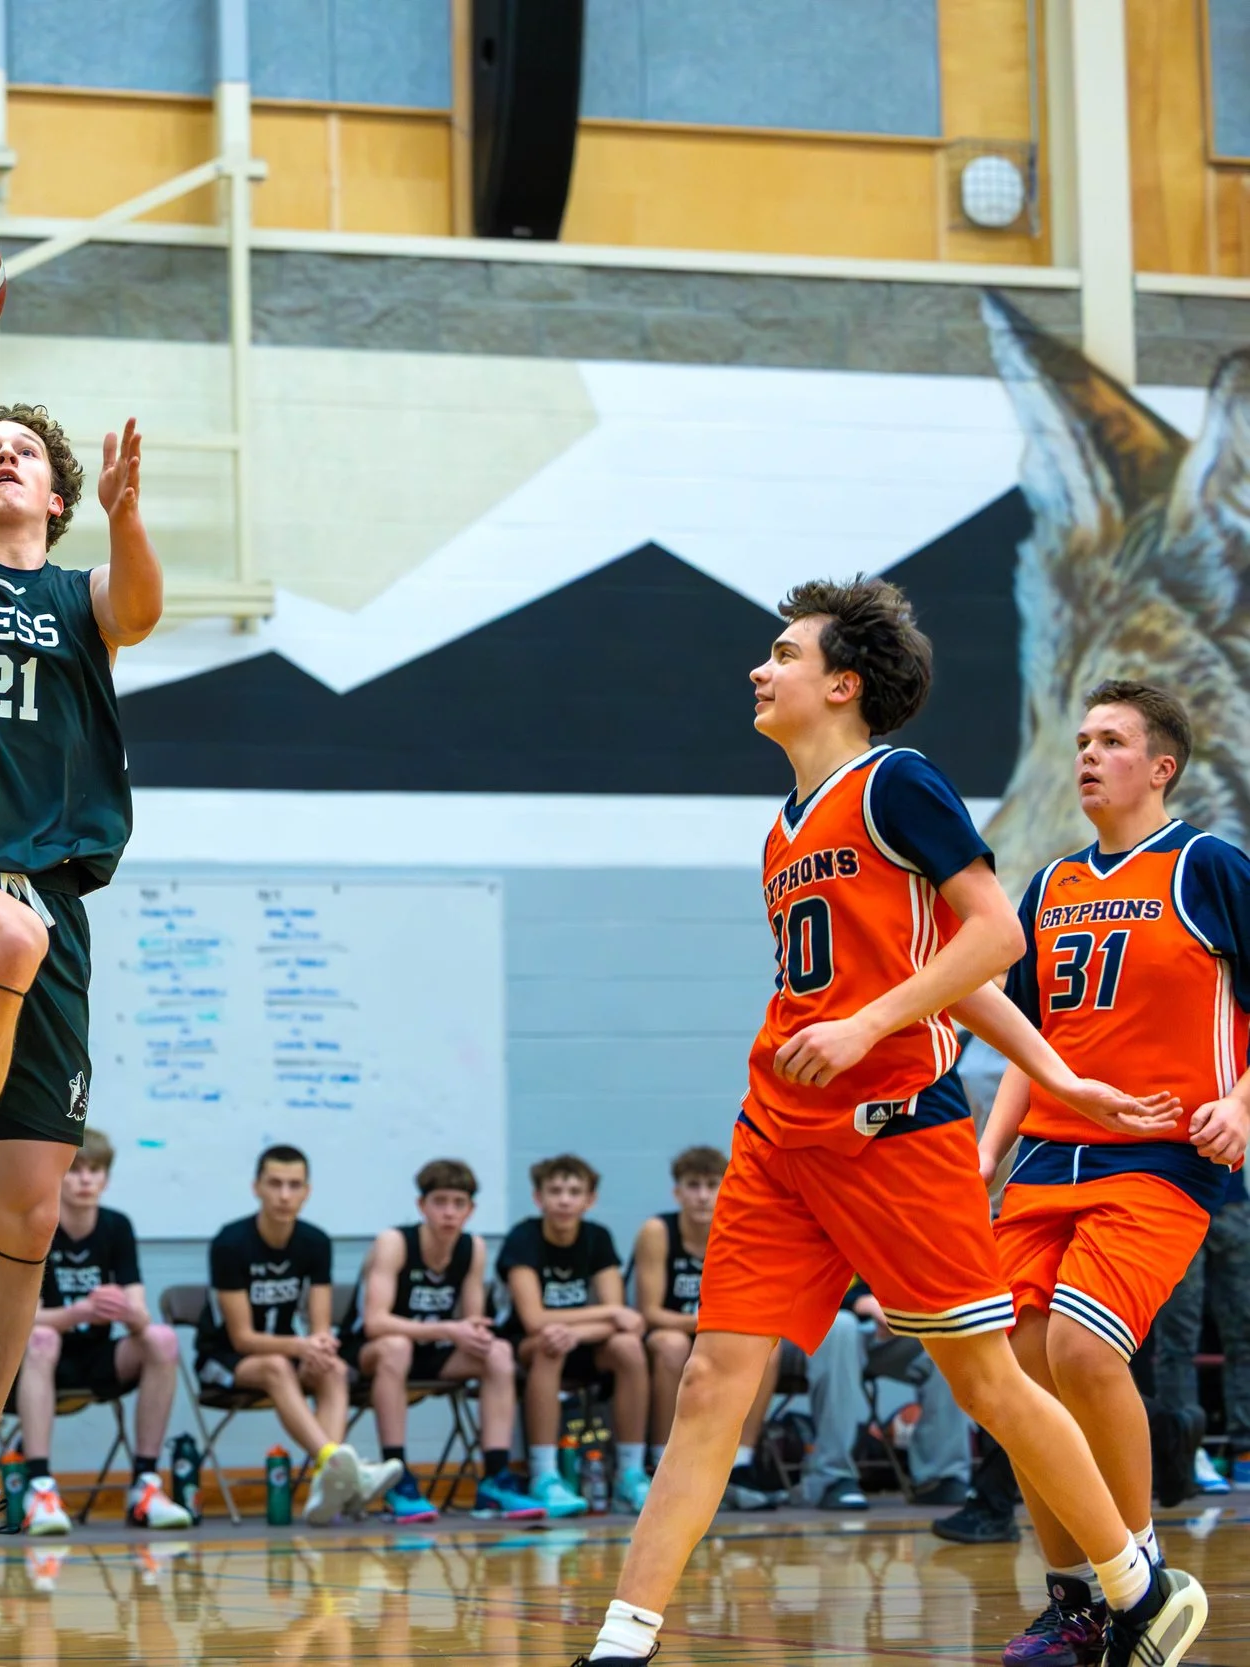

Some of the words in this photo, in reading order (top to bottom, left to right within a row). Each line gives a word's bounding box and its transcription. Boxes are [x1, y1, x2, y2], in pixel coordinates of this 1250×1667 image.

[764, 847, 860, 910] YPHONS
[1038, 898, 1164, 931] GRYPHONS
[771, 895, 835, 1000] 10
[1049, 929, 1131, 1013] 31
[250, 1277, 300, 1305] GESS
